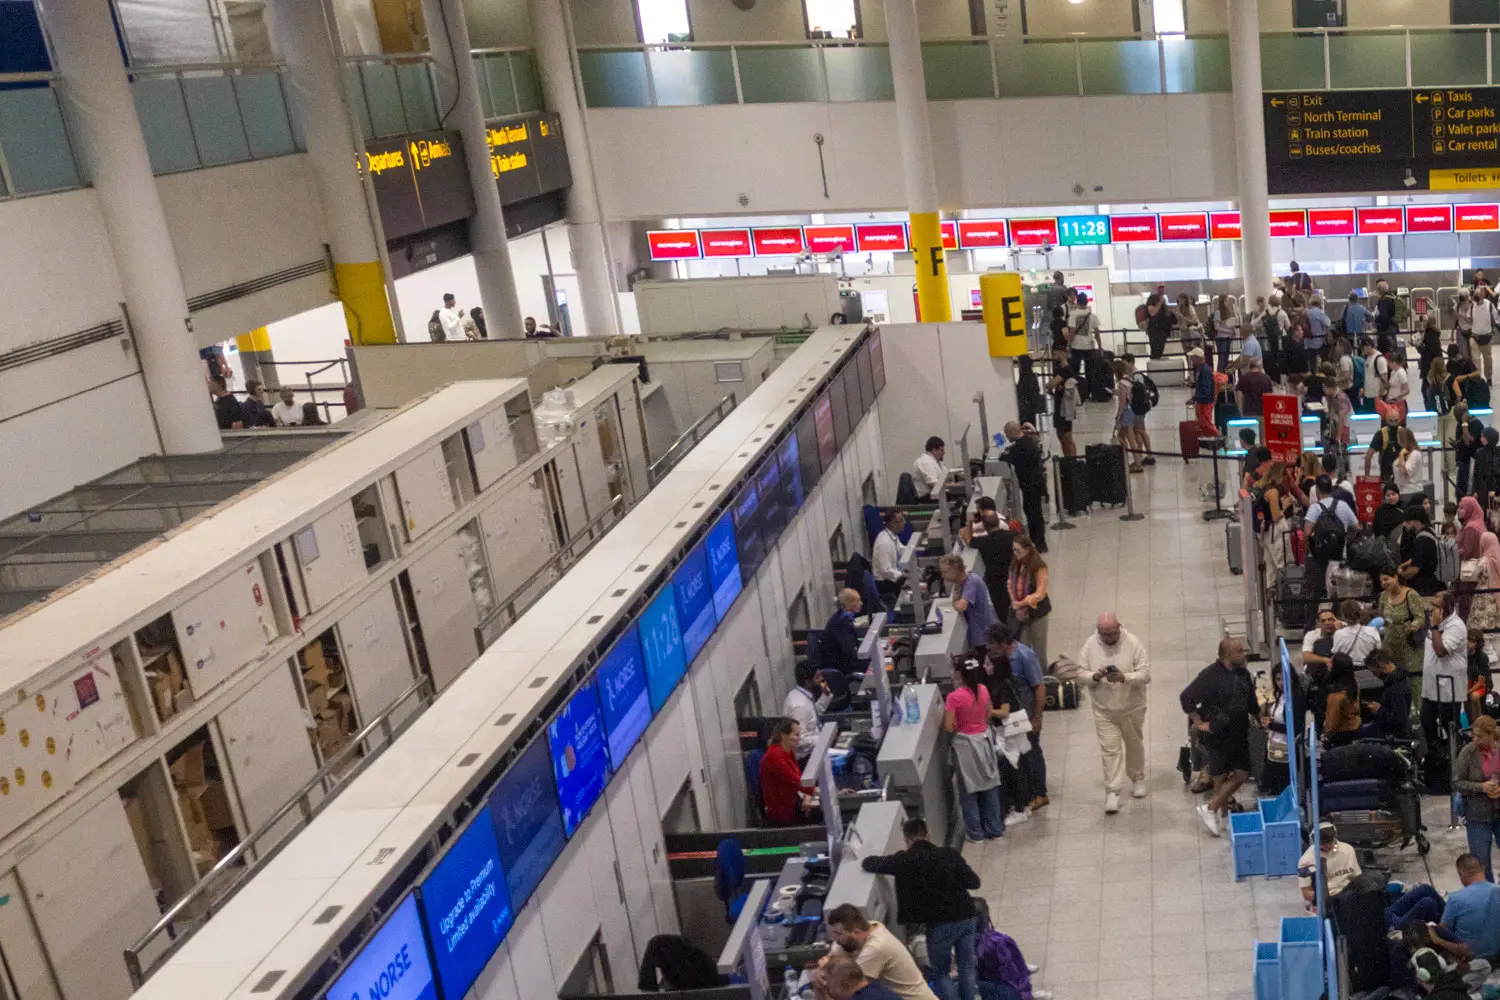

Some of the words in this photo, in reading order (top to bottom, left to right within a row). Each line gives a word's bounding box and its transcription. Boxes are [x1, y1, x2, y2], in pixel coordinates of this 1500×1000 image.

[1303, 96, 1322, 106] Exit
[1448, 91, 1473, 102] Taxis
[1304, 111, 1335, 122] North
[1337, 109, 1381, 121] Terminal
[1448, 107, 1465, 118] Car
[1468, 107, 1495, 119] parks
[1304, 127, 1330, 138] Train
[1333, 127, 1369, 138] station
[1448, 123, 1473, 134] Valet
[1306, 142, 1381, 155] Buses/coaches
[1448, 140, 1466, 151] Car
[1468, 138, 1497, 151] rental
[366, 151, 404, 175] Departures
[1454, 172, 1487, 184] Toilets
[1062, 221, 1106, 236] 11:28
[930, 246, 944, 276] F
[1002, 296, 1024, 337] E
[644, 602, 680, 676] 11:28
[614, 656, 635, 693] NORSE
[439, 897, 464, 935] Upgrade
[464, 888, 472, 902] to
[470, 858, 494, 894] Premium
[447, 915, 469, 952] Limited
[469, 881, 495, 925] availability
